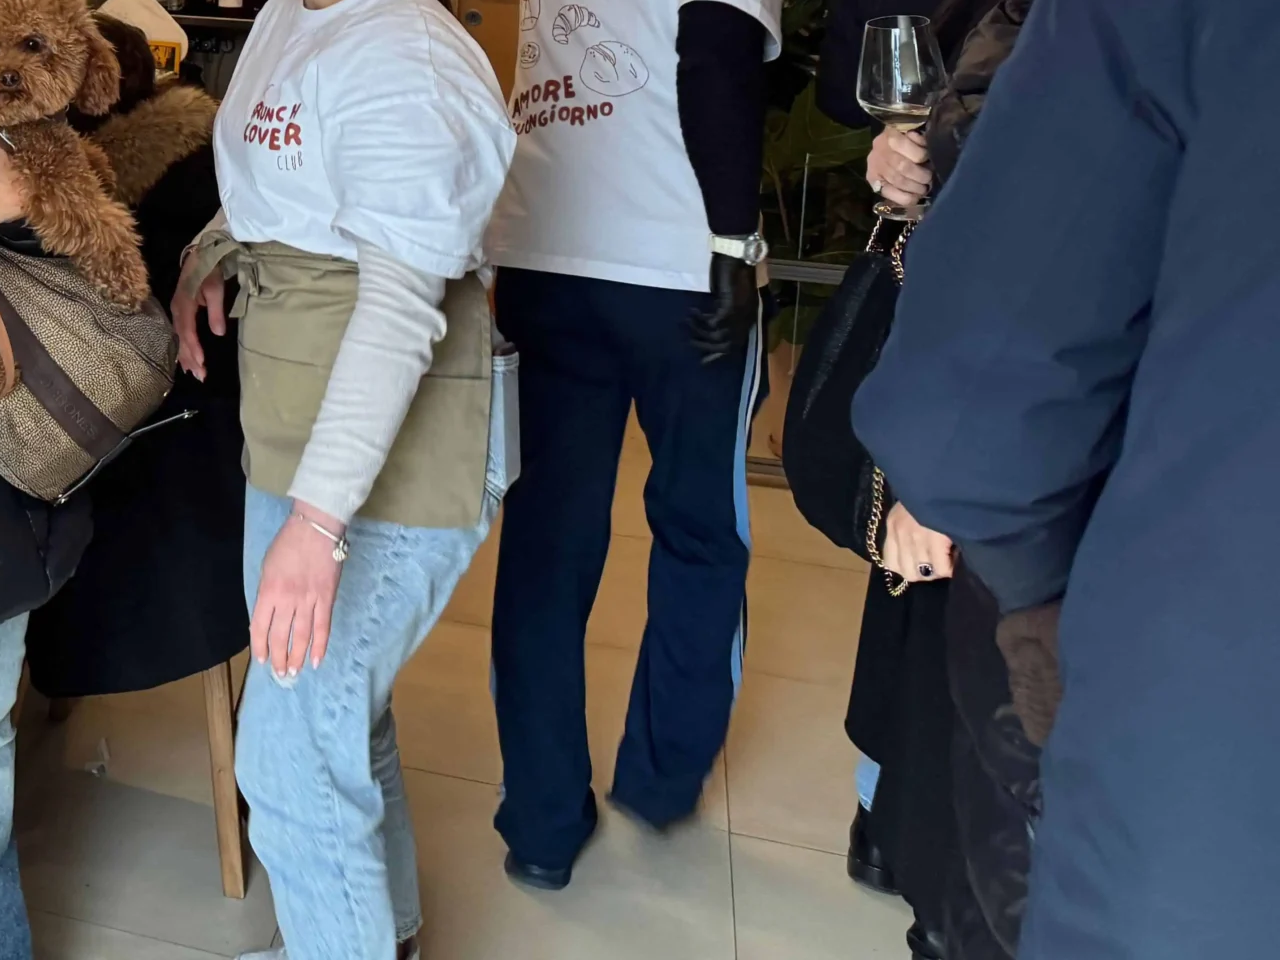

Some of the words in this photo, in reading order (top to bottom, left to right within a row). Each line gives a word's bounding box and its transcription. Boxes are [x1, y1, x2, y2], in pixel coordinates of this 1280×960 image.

[512, 75, 576, 119] AMORE
[243, 122, 303, 151] LOVER
[277, 151, 303, 171] CLUB
